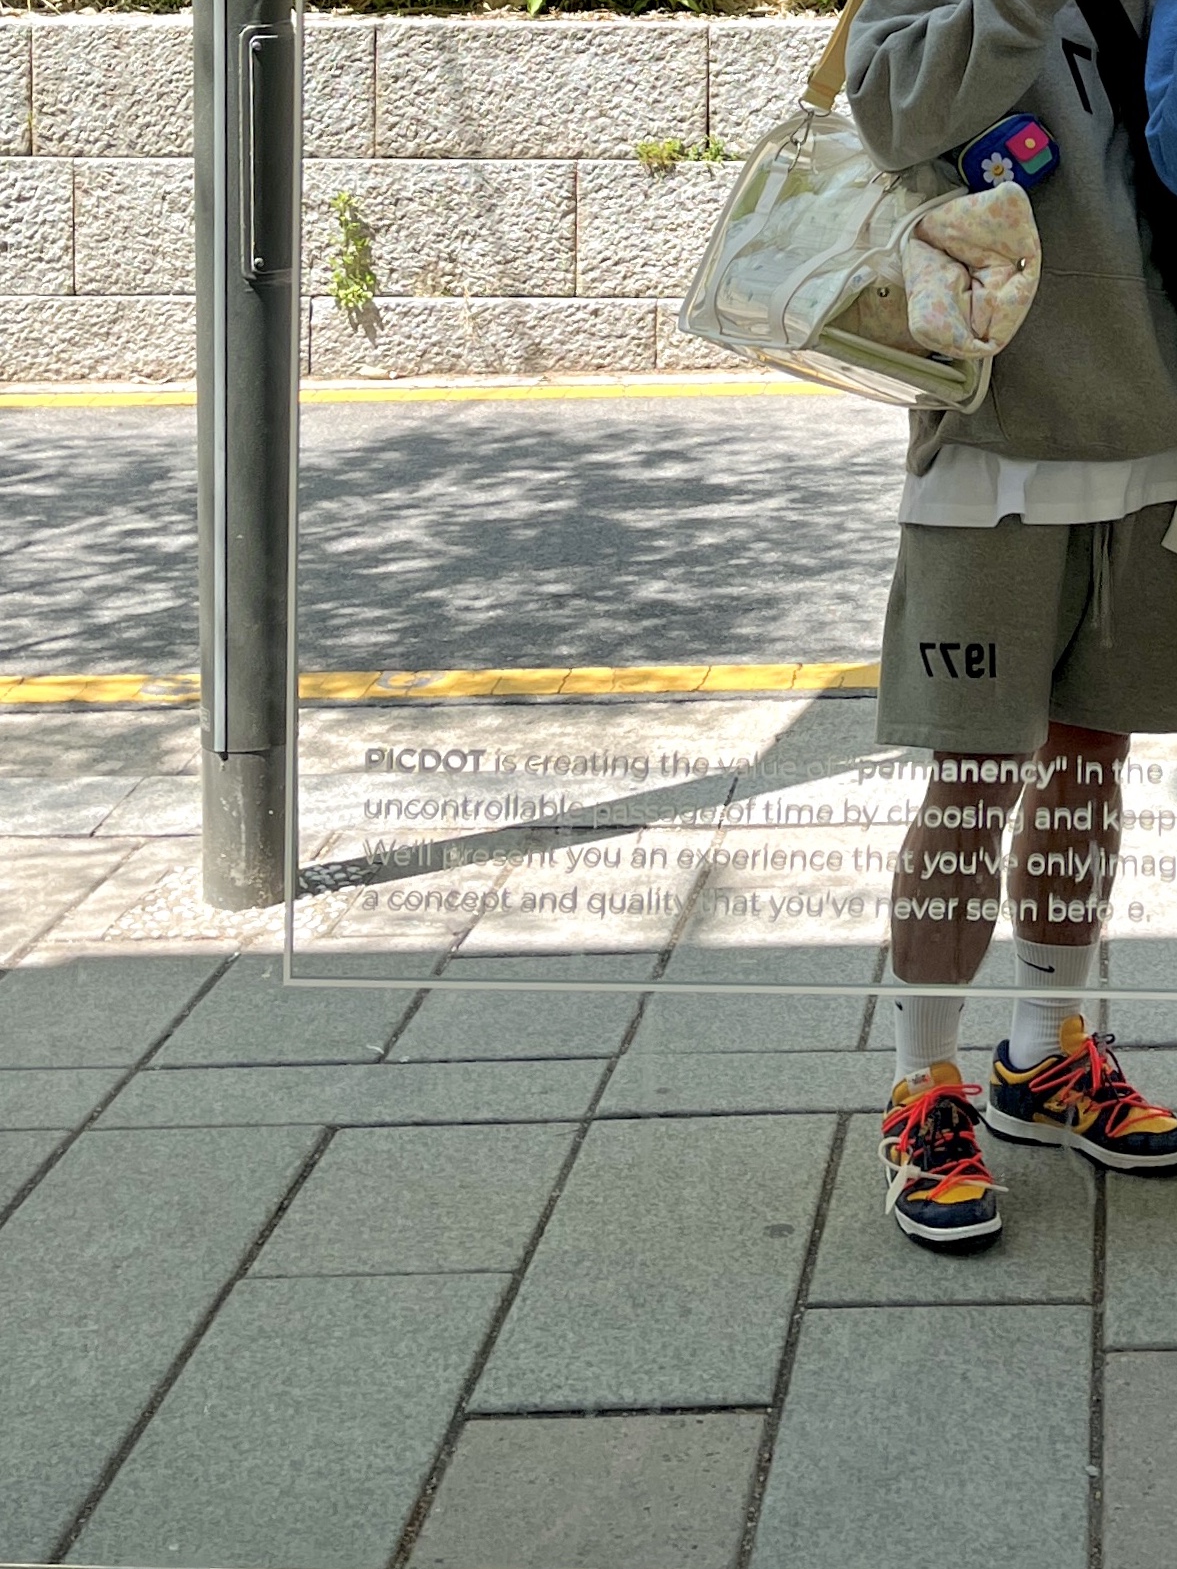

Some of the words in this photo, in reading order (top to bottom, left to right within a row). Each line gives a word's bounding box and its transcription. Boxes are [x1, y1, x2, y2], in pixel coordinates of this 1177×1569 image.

[364, 747, 487, 774] PICDOT
[495, 748, 518, 775] is
[524, 749, 650, 782] creating
[660, 750, 710, 777] the
[717, 751, 804, 779] value
[806, 751, 837, 779] of
[1076, 755, 1104, 785] in
[1112, 756, 1164, 785] the
[363, 793, 585, 822] uncontrollable
[592, 800, 717, 830] passage
[726, 797, 757, 824] of
[763, 797, 834, 824] time
[843, 797, 880, 831] by
[887, 798, 1025, 835] choosing
[1034, 800, 1093, 831] and
[363, 838, 435, 868] We'll
[442, 842, 558, 871] present
[565, 845, 622, 874] you
[630, 846, 668, 870] an
[676, 843, 844, 872] experience
[852, 844, 915, 874] that
[921, 846, 1019, 880] you've
[1026, 846, 1093, 883] only
[361, 888, 379, 912] a
[387, 886, 513, 918] concept
[520, 885, 578, 914] and
[586, 886, 686, 920] quality
[702, 887, 762, 916] that
[768, 890, 866, 922] you've
[875, 895, 959, 921] never
[965, 895, 1038, 922] seen
[1047, 892, 1152, 923] befoe.
